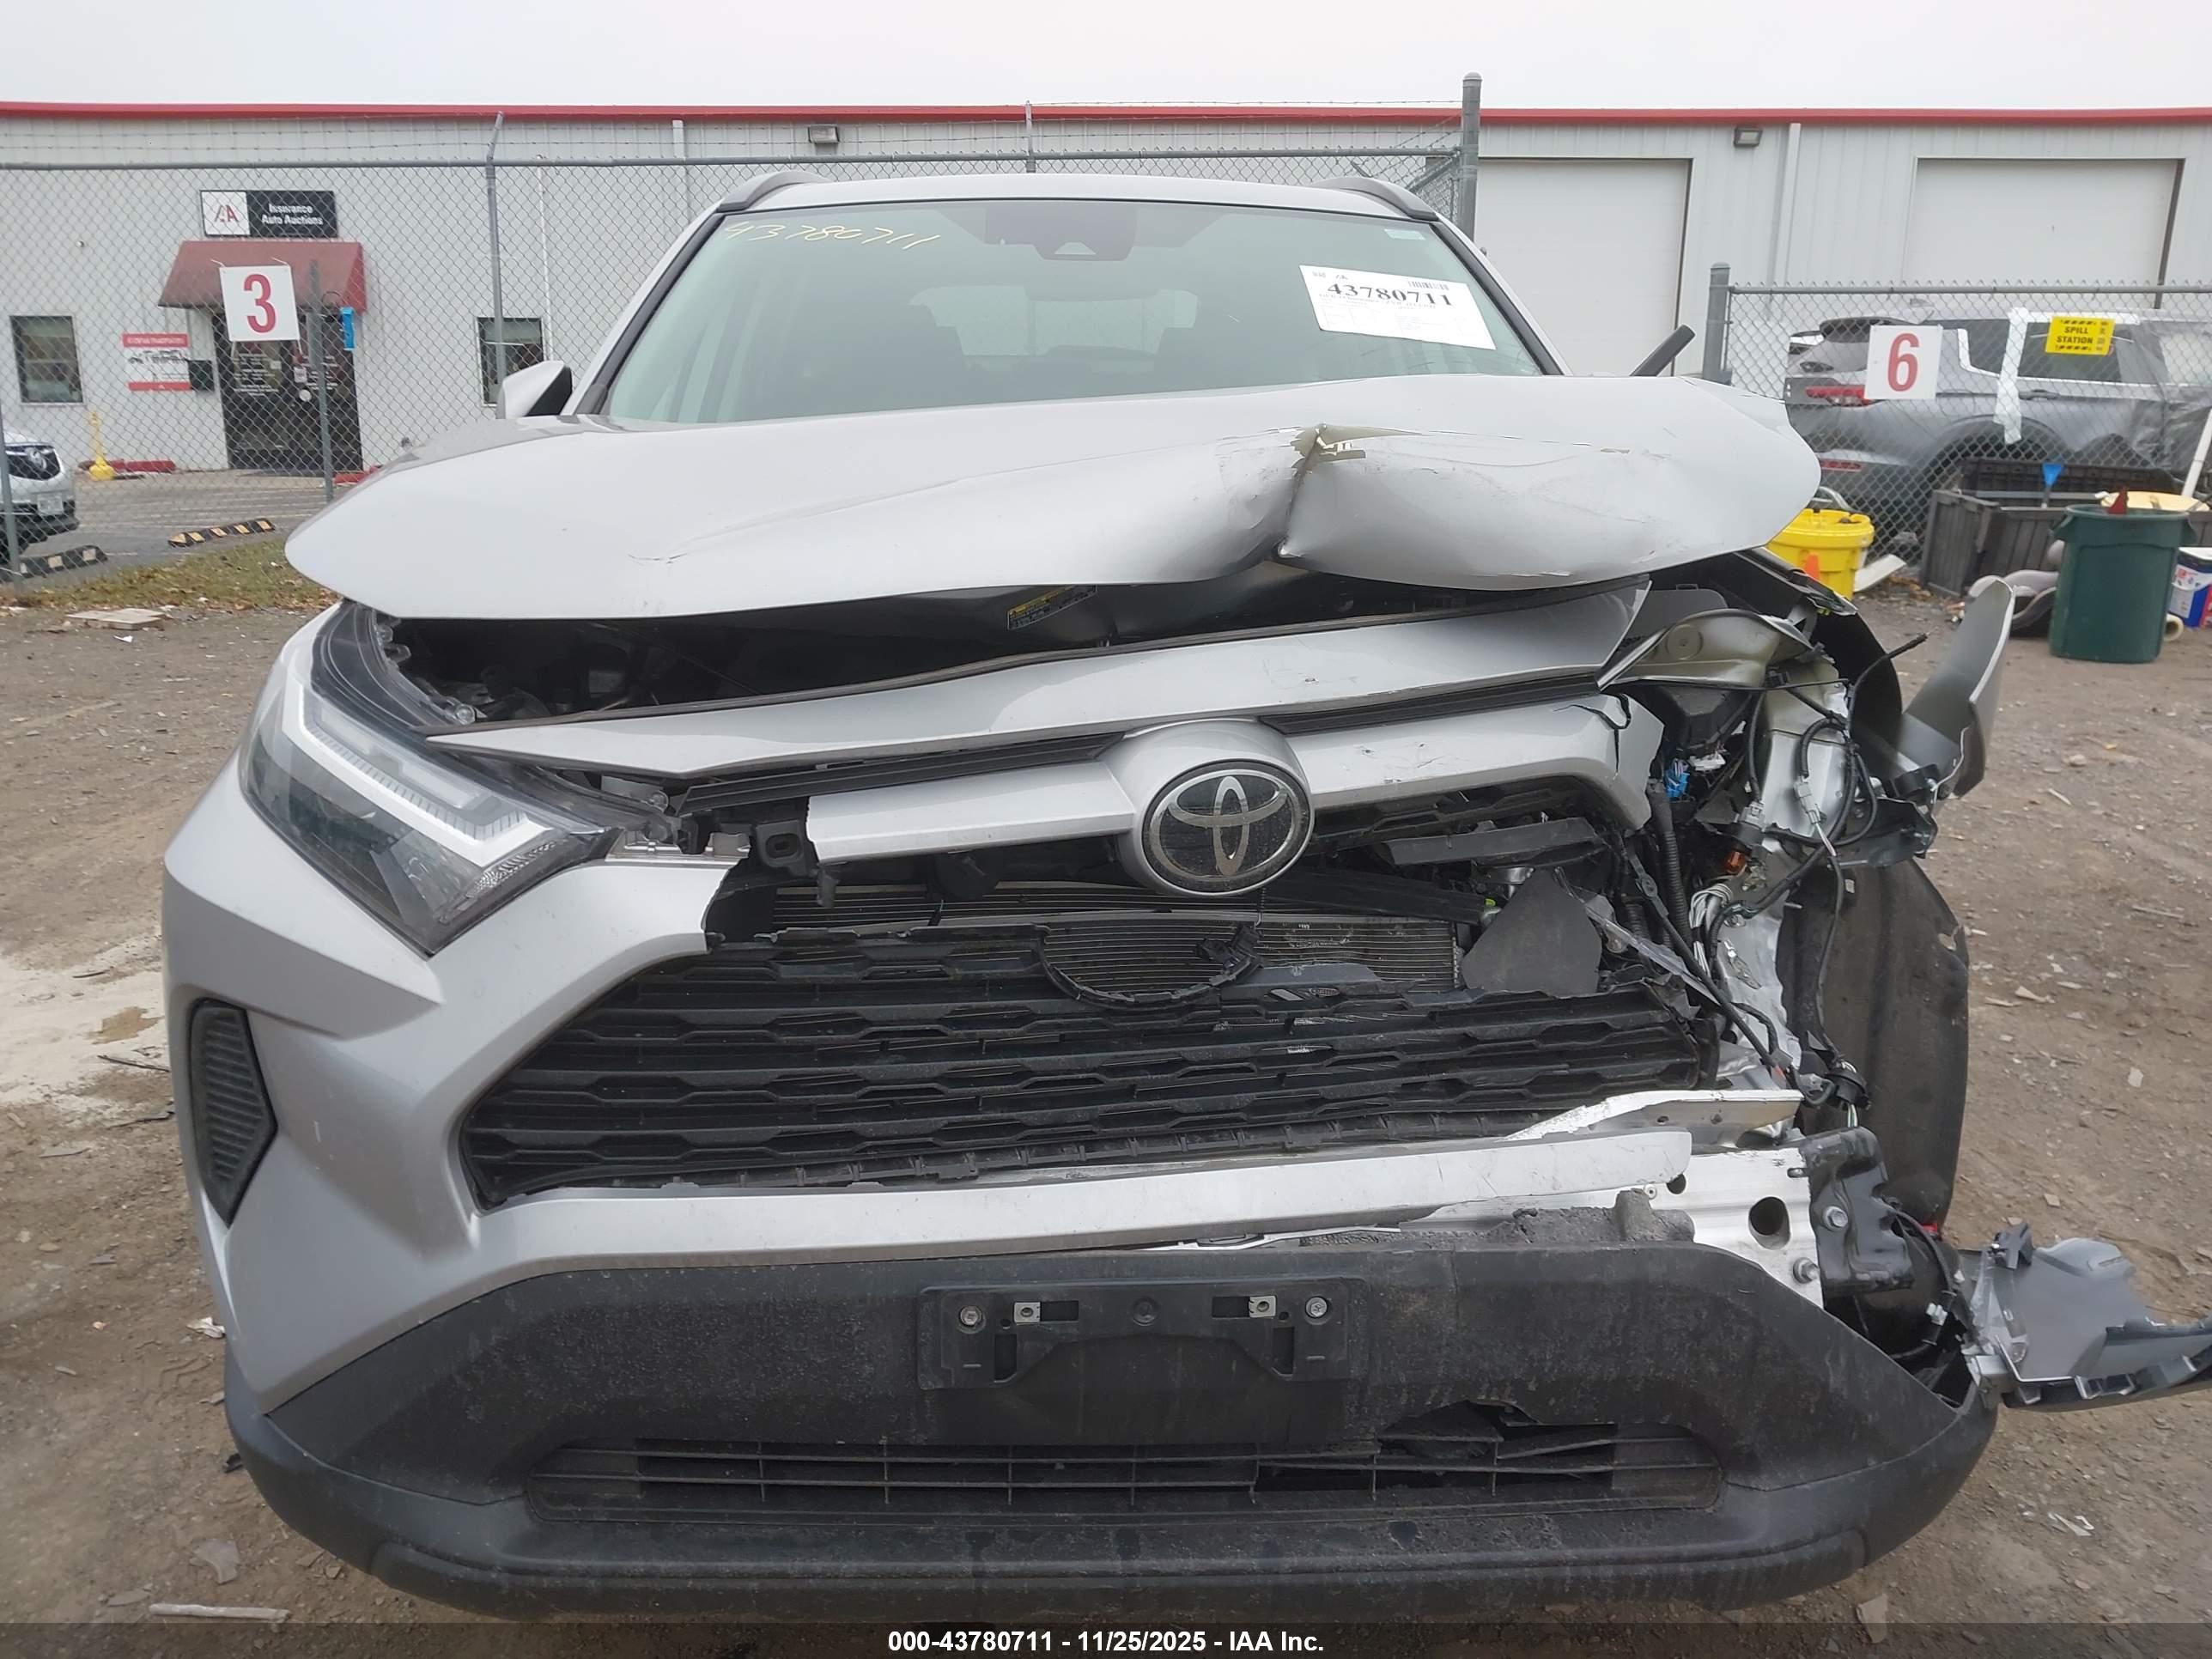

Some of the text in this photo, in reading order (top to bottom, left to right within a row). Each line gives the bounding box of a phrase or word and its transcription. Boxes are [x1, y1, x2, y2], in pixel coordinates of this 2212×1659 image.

[269, 203, 313, 214] Insurance
[261, 214, 324, 226] Auto Auctions
[244, 274, 276, 333] 3
[1328, 283, 1453, 307] 43780711
[2057, 335, 2094, 344] STATION
[1887, 332, 1920, 392] 6
